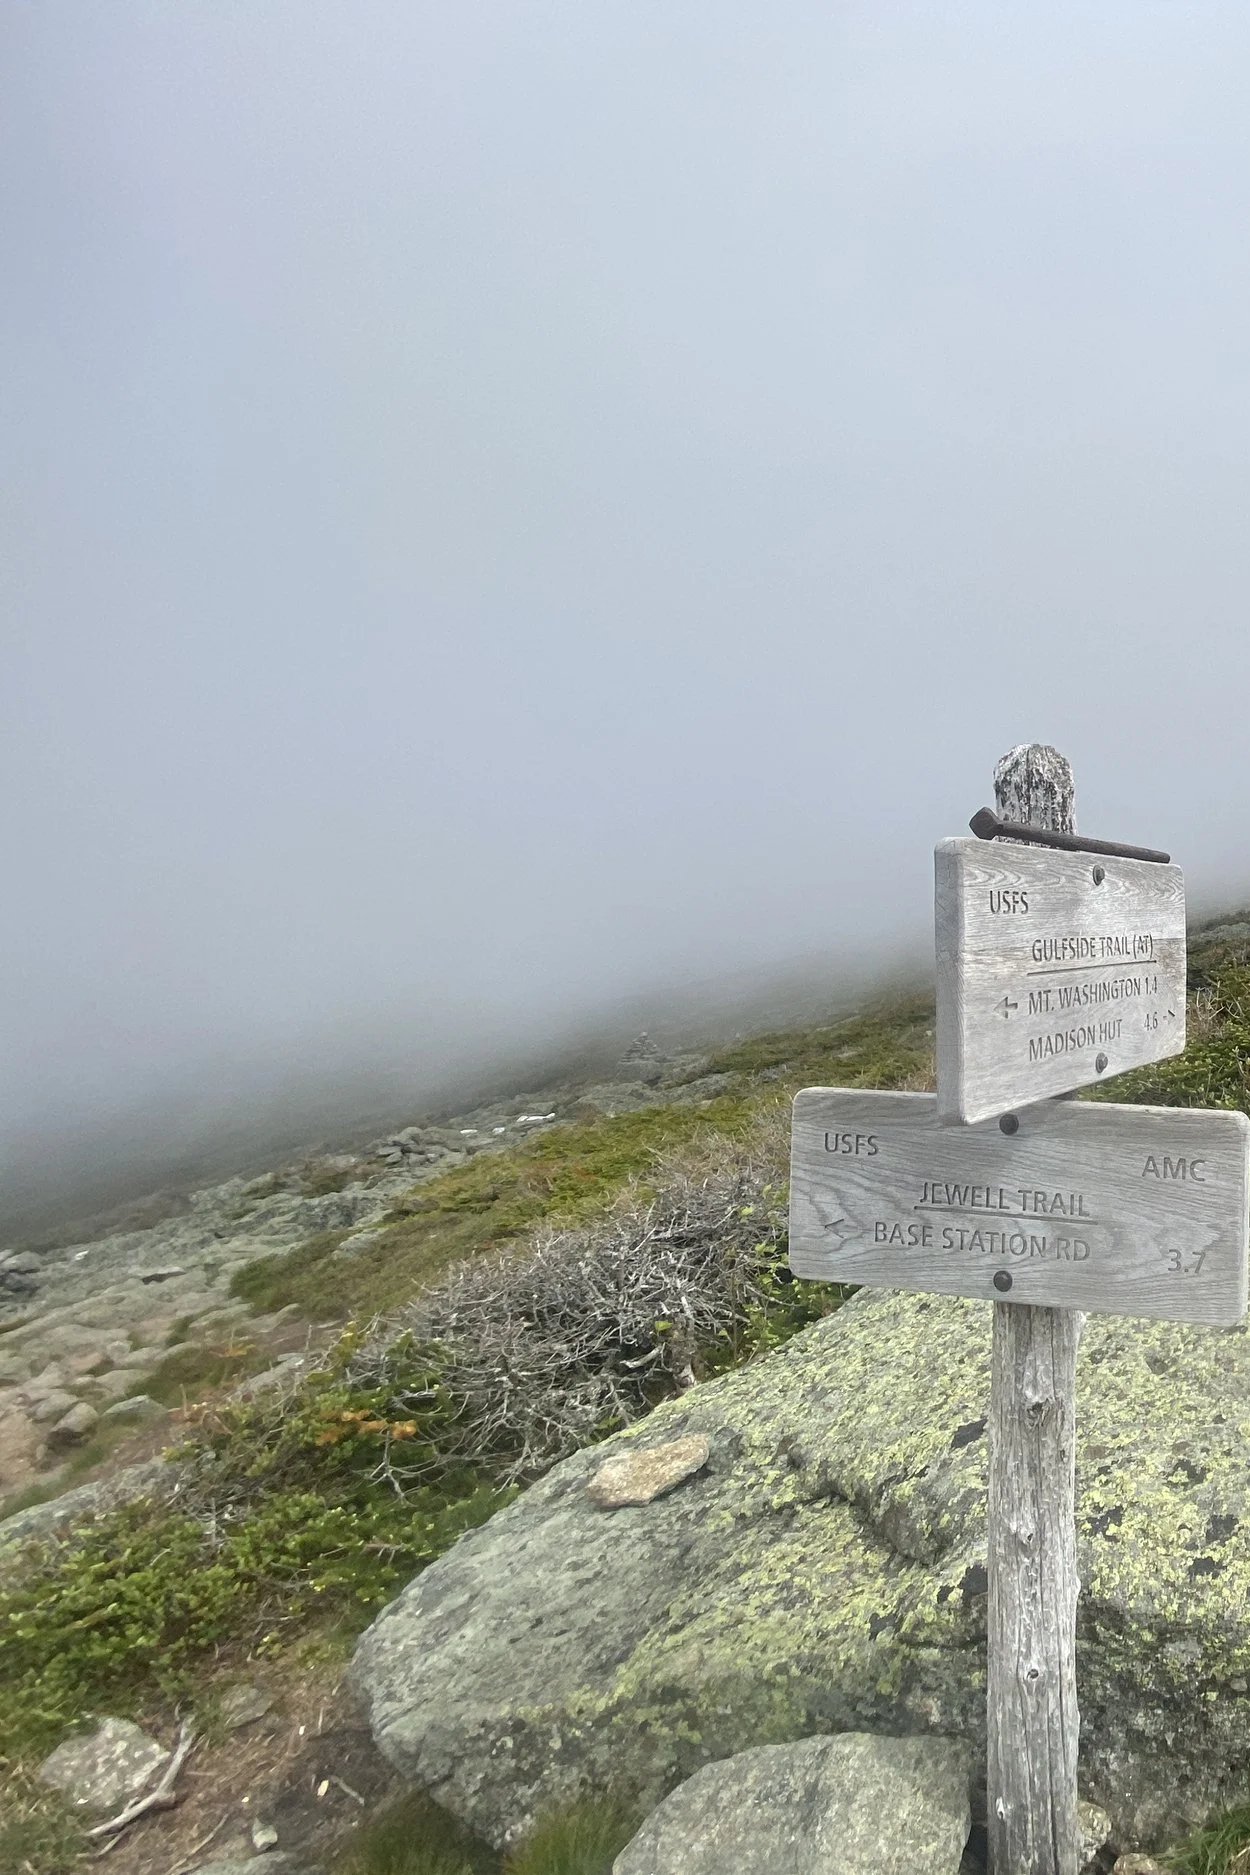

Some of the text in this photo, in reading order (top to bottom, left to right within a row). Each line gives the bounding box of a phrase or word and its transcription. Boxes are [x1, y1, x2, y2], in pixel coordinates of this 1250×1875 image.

[989, 890, 1029, 914] USFS
[1032, 934, 1154, 962] GULFSIDE TRAIL (AT)
[1028, 976, 1158, 1015] MT. WASHINGTON 1.4
[1029, 1011, 1159, 1062] MADISON HUT 4.6
[824, 1131, 879, 1156] USFS
[1141, 1156, 1207, 1182] AMC
[920, 1181, 1090, 1217] JEWELL TRAIL
[874, 1221, 1207, 1274] BASE STATION RD 3.7
